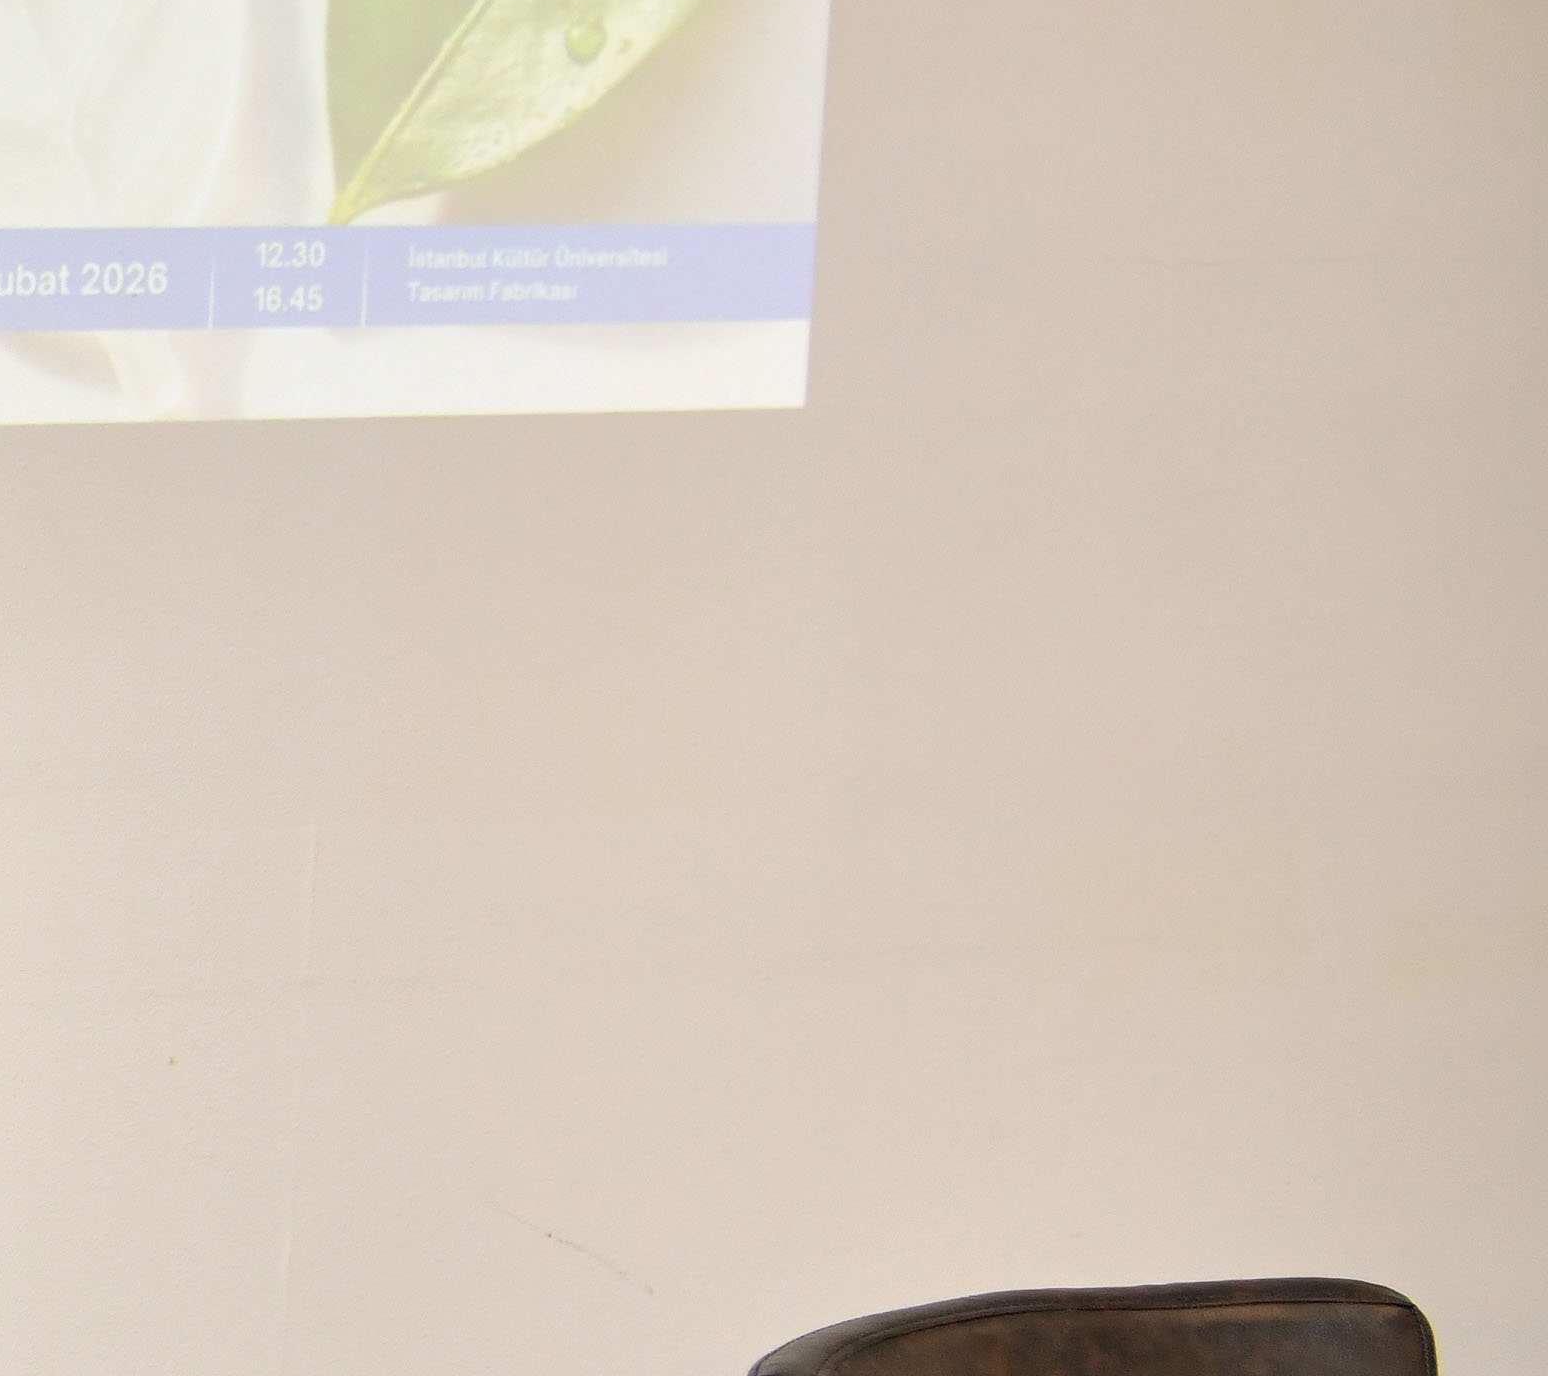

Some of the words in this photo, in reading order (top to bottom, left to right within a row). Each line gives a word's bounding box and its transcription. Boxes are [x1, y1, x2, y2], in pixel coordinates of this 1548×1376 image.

[256, 240, 326, 268] 12.30
[81, 262, 168, 296] 2026
[254, 284, 324, 312] 16.45
